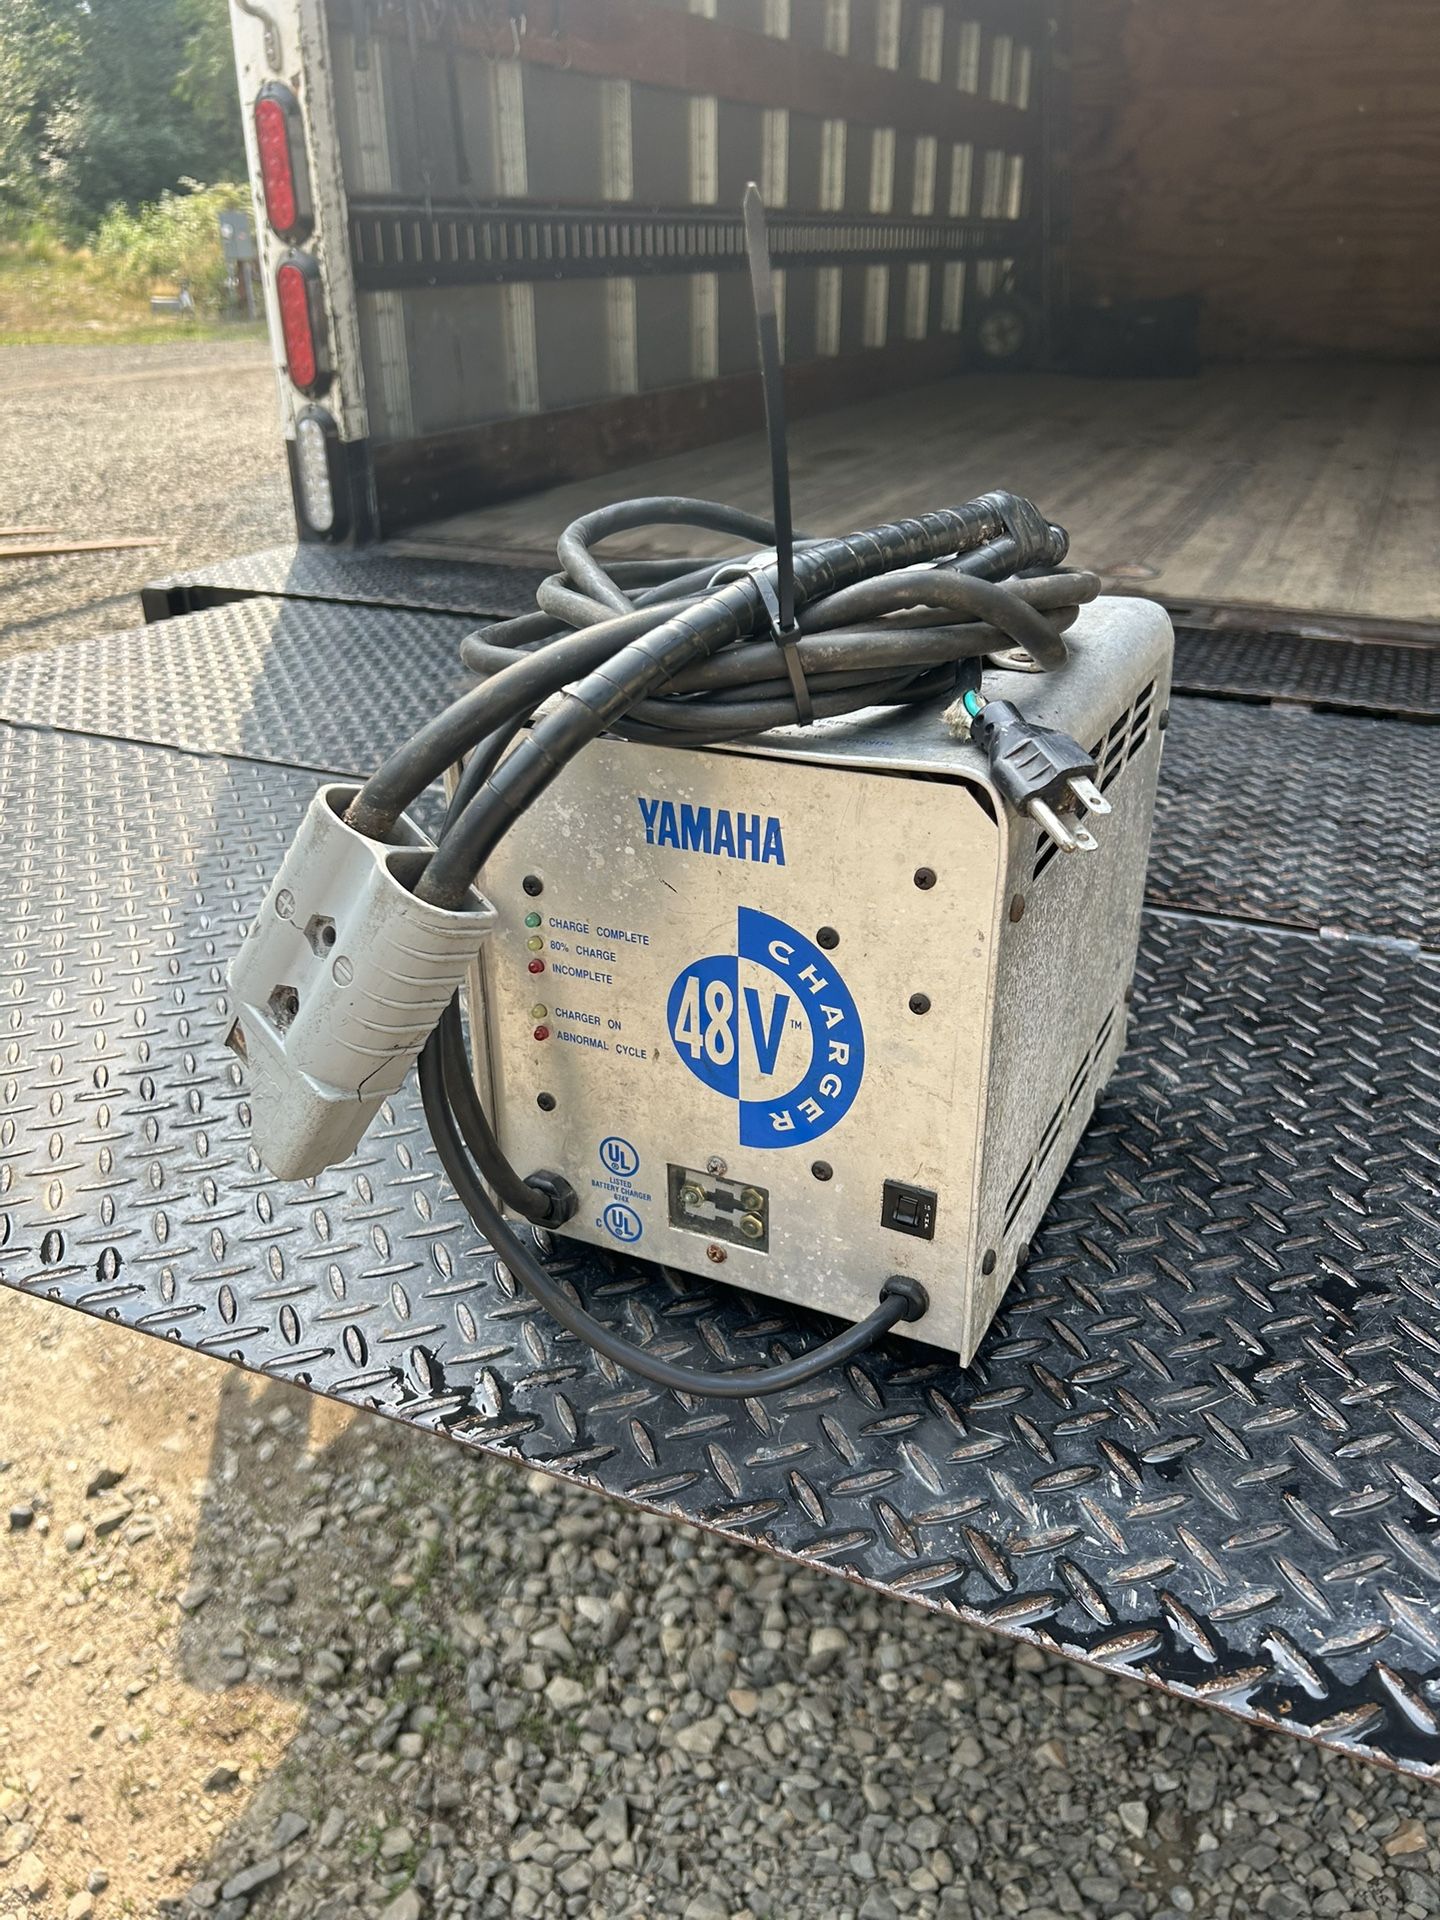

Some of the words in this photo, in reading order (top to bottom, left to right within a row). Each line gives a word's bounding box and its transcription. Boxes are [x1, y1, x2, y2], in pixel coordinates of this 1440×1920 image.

[638, 797, 786, 866] YAMAHA
[549, 917, 590, 934] CHARGE
[596, 926, 650, 946] COMPLETE
[550, 940, 569, 953] 80%
[576, 945, 617, 962] CHARGE
[552, 963, 613, 985] INCOMPLETE
[555, 1007, 601, 1026] CHARGER
[607, 1019, 622, 1031] ON
[674, 976, 791, 1076] 48V
[556, 1030, 609, 1051] ABNORMAL
[615, 1044, 647, 1060] CYCLE
[768, 939, 850, 1133] CHARGER
[608, 1143, 631, 1170] UL
[591, 1179, 619, 1192] BATTERY
[620, 1187, 652, 1201] CHARGER
[609, 1176, 632, 1189] LISTED
[611, 1209, 634, 1236] UL
